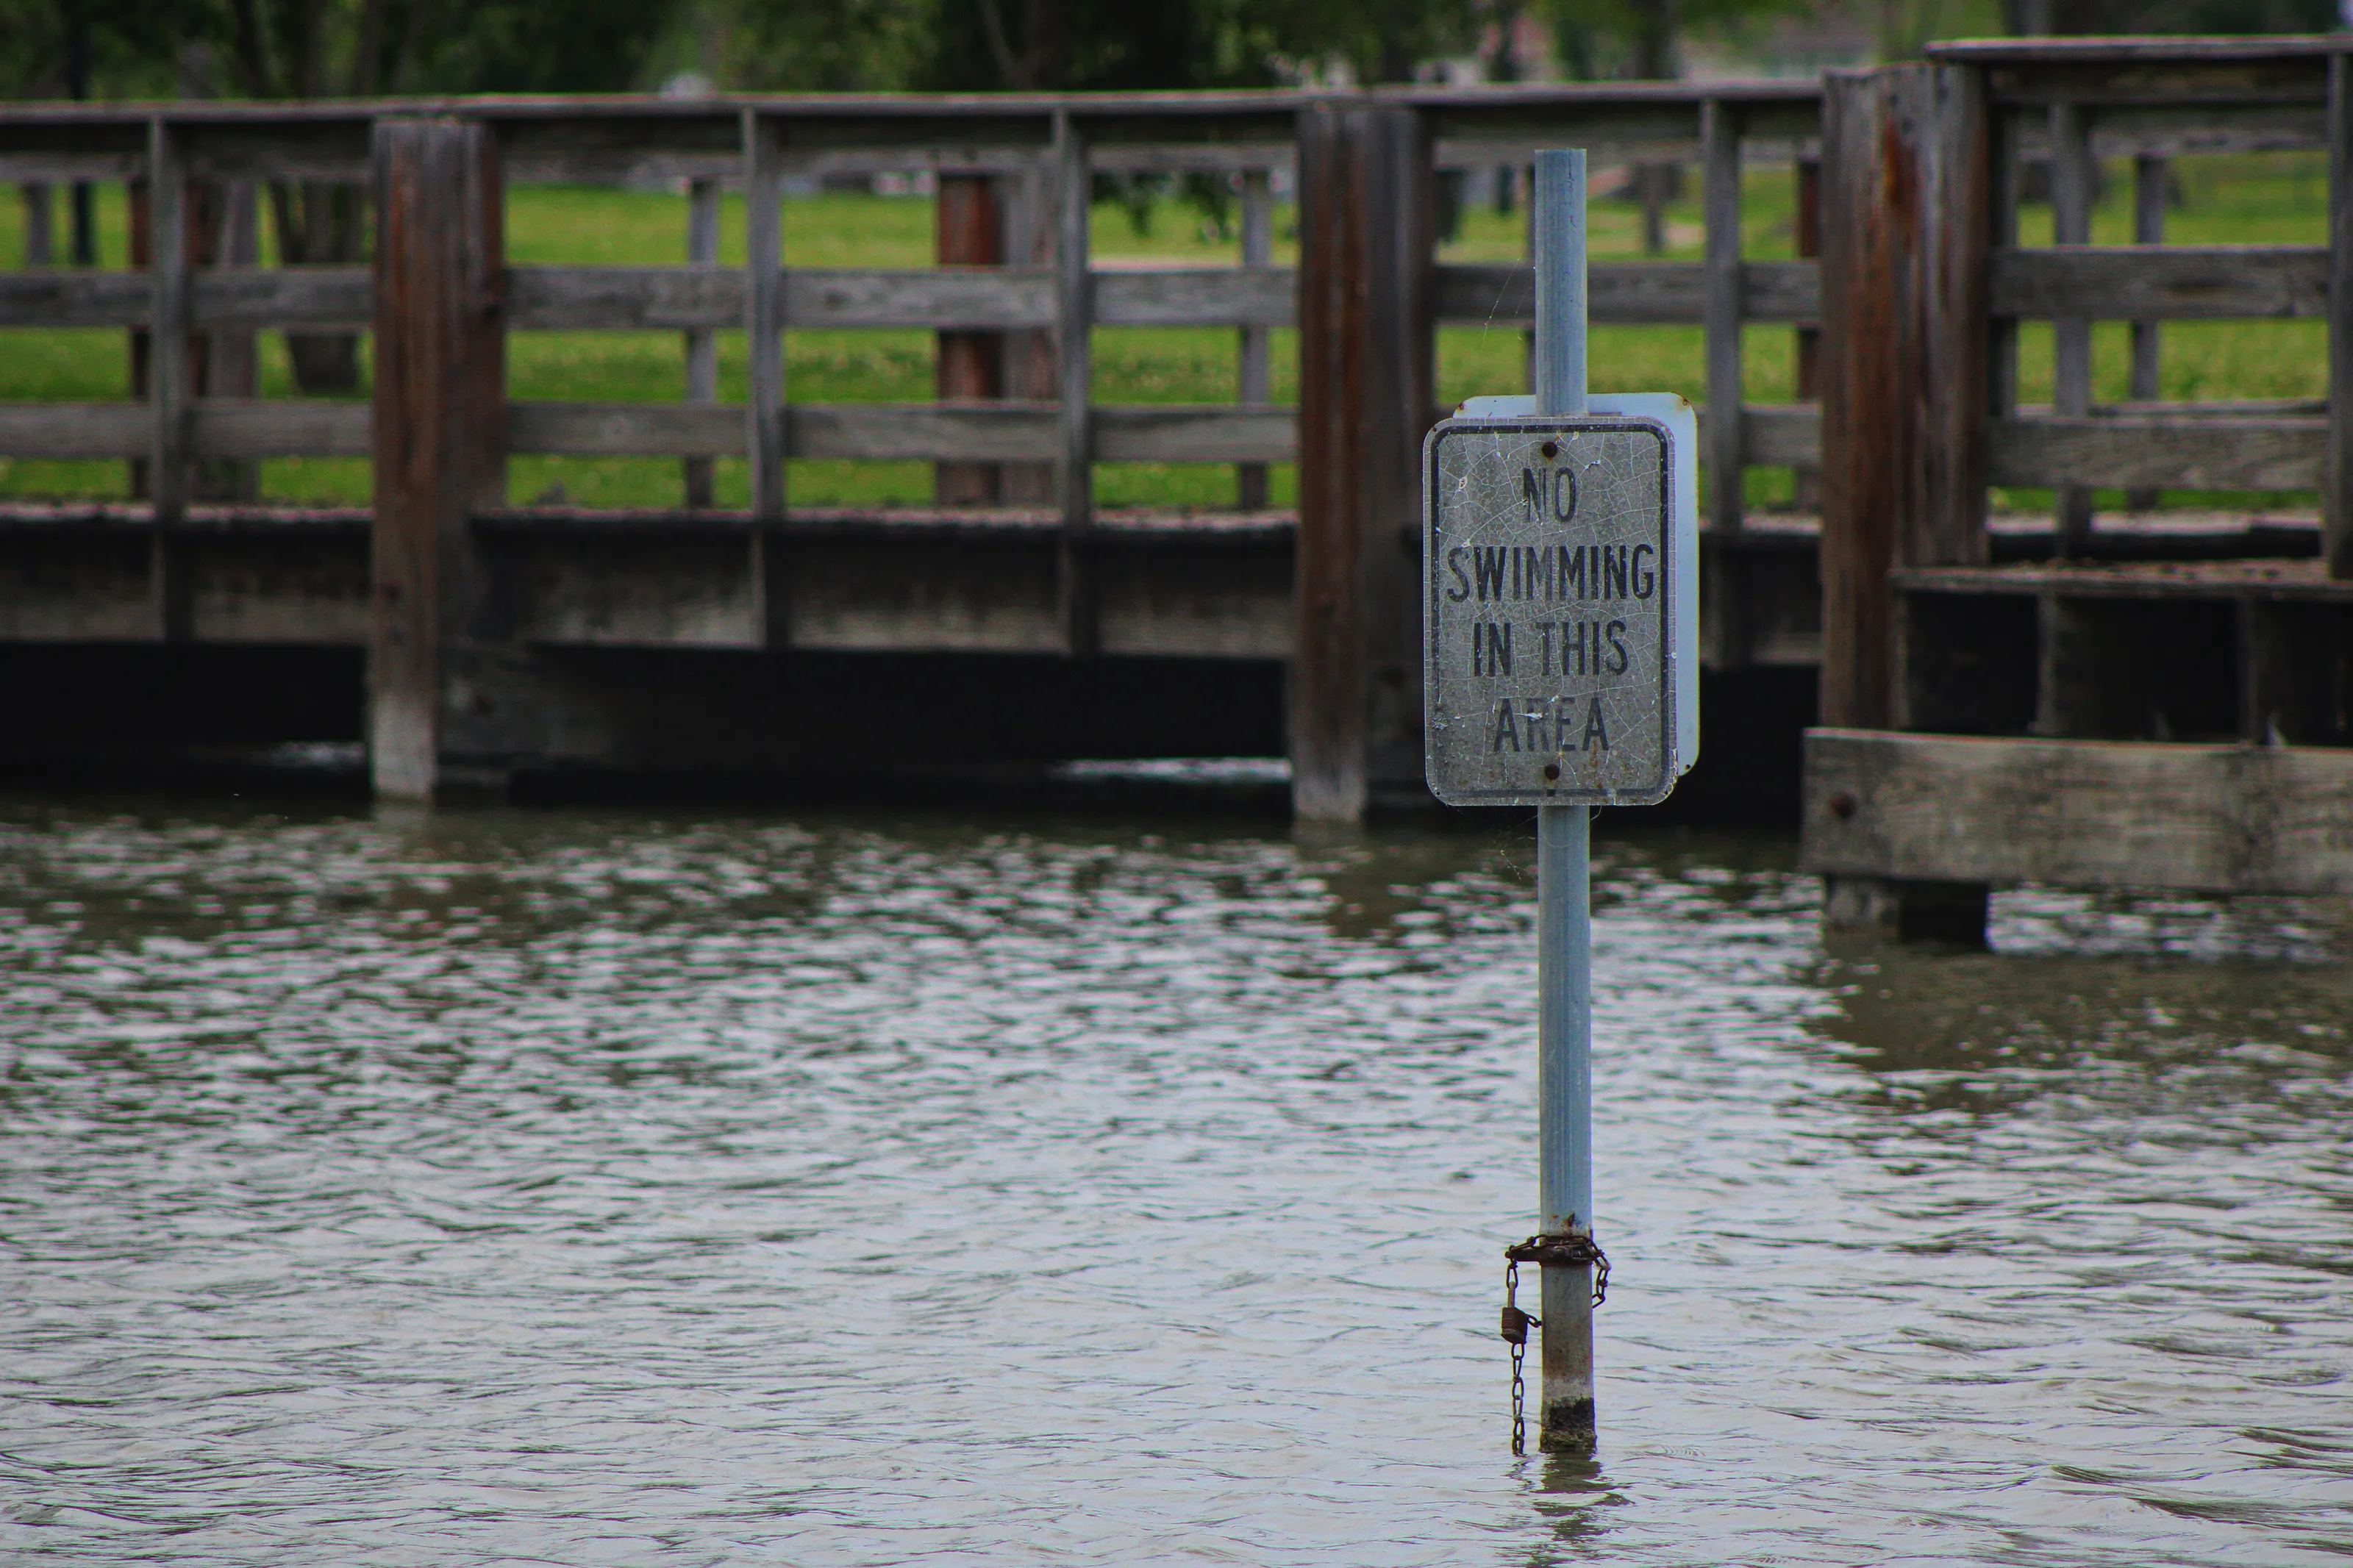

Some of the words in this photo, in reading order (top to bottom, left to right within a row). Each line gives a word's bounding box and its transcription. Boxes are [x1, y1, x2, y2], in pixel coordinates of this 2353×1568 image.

[1524, 466, 1576, 523] NO
[1446, 543, 1654, 602] SWIMMING
[1474, 622, 1511, 676] IN
[1536, 620, 1628, 676] THIS
[1494, 697, 1610, 753] AREA
